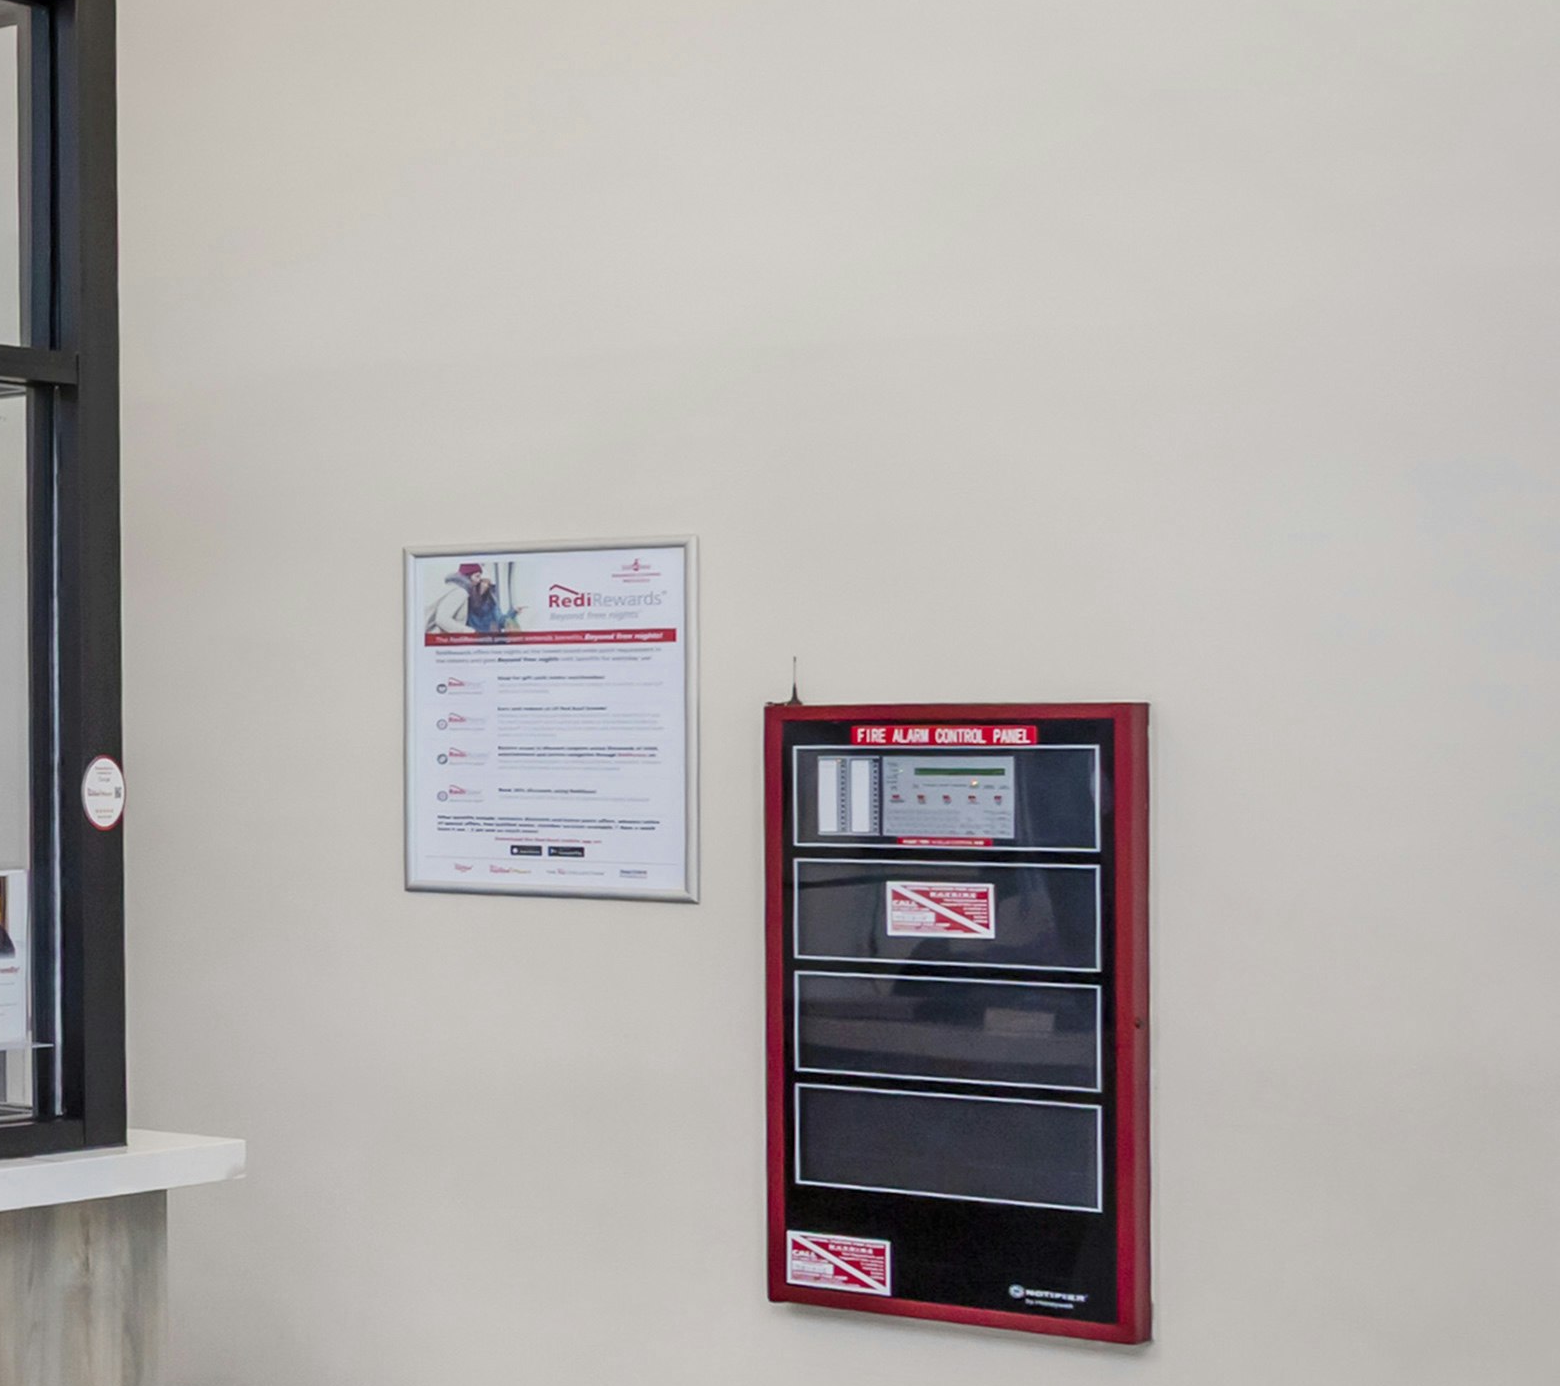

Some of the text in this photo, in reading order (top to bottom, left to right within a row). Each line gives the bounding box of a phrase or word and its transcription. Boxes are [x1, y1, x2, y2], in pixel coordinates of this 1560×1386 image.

[549, 591, 662, 608] RediRewards
[857, 728, 1031, 744] FIRE ALARM CONTROL PANEL
